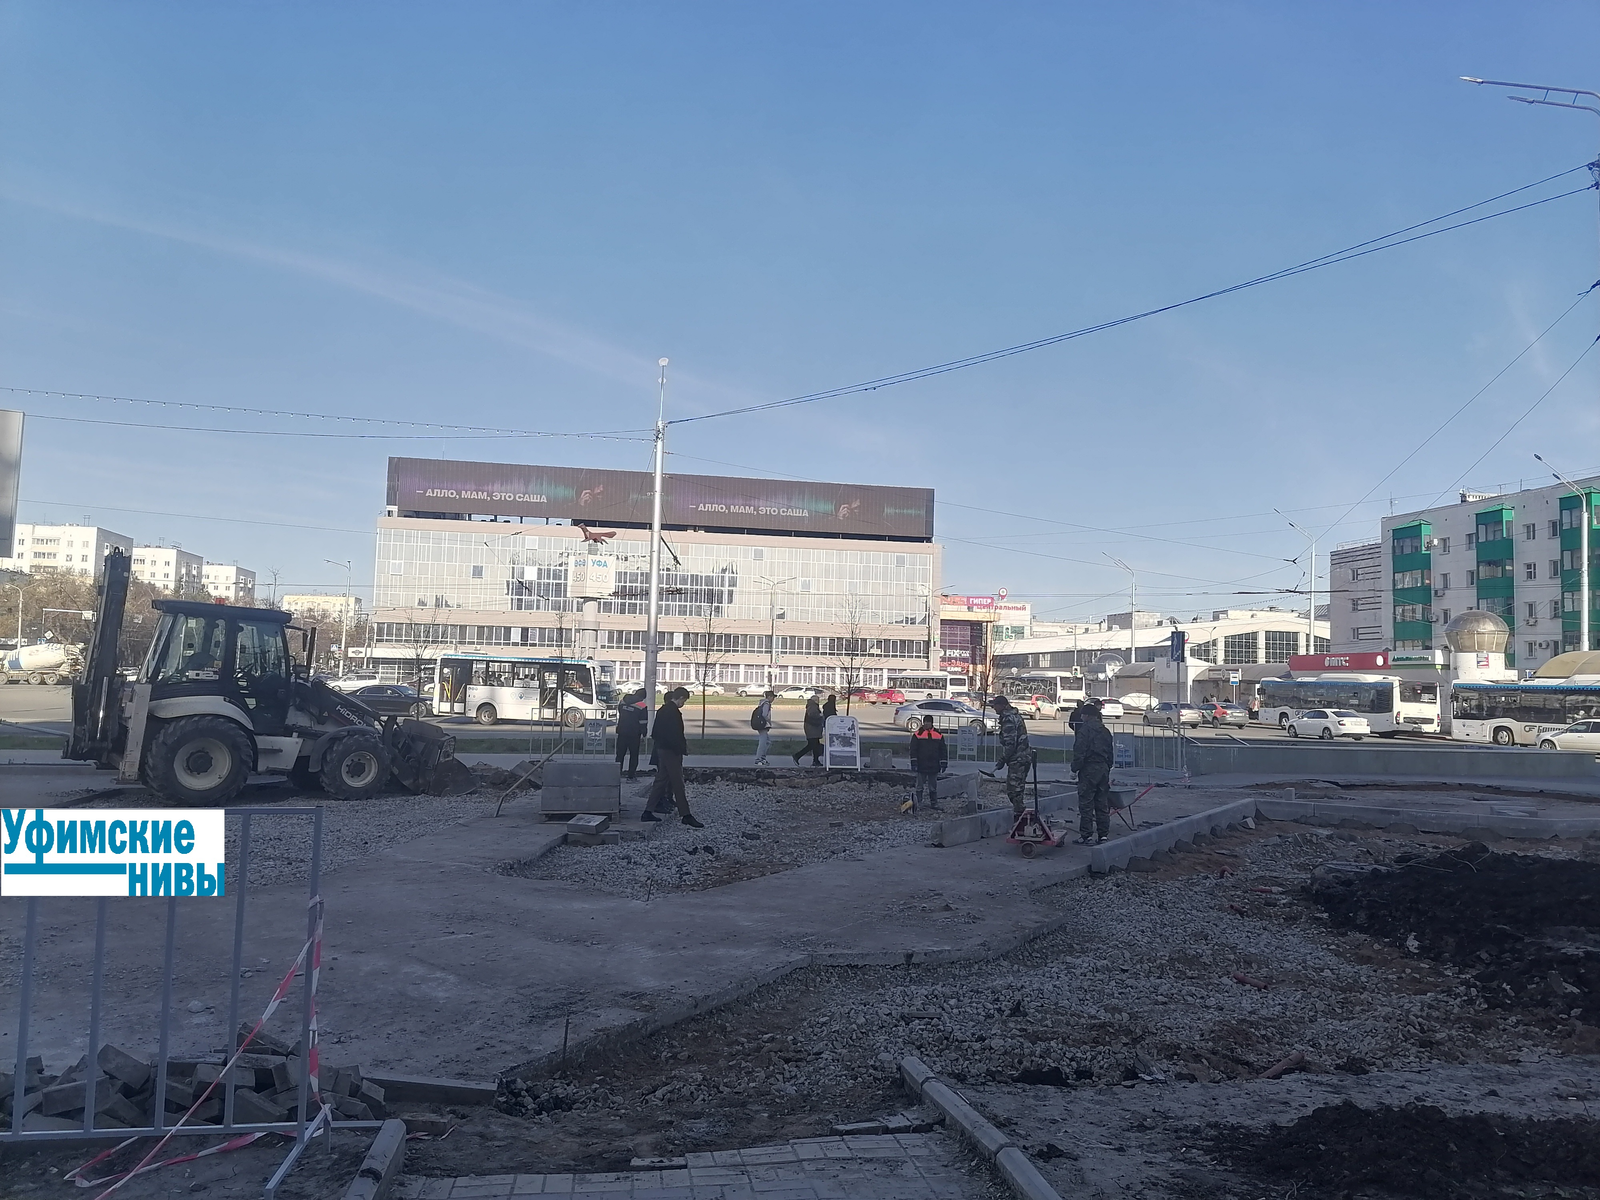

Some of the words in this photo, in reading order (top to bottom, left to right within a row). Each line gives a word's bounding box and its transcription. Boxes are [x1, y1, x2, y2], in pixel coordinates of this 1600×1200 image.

[425, 488, 459, 499] АЛЛО,
[461, 490, 491, 501] МАМ,
[492, 492, 514, 501] ЭТО
[515, 493, 547, 503] САША
[698, 503, 728, 514] АЛЛО,
[730, 505, 757, 515] МАМ,
[758, 506, 779, 515] ЭТО
[780, 507, 809, 517] САША
[590, 559, 608, 568] УФА
[588, 572, 610, 584] 450
